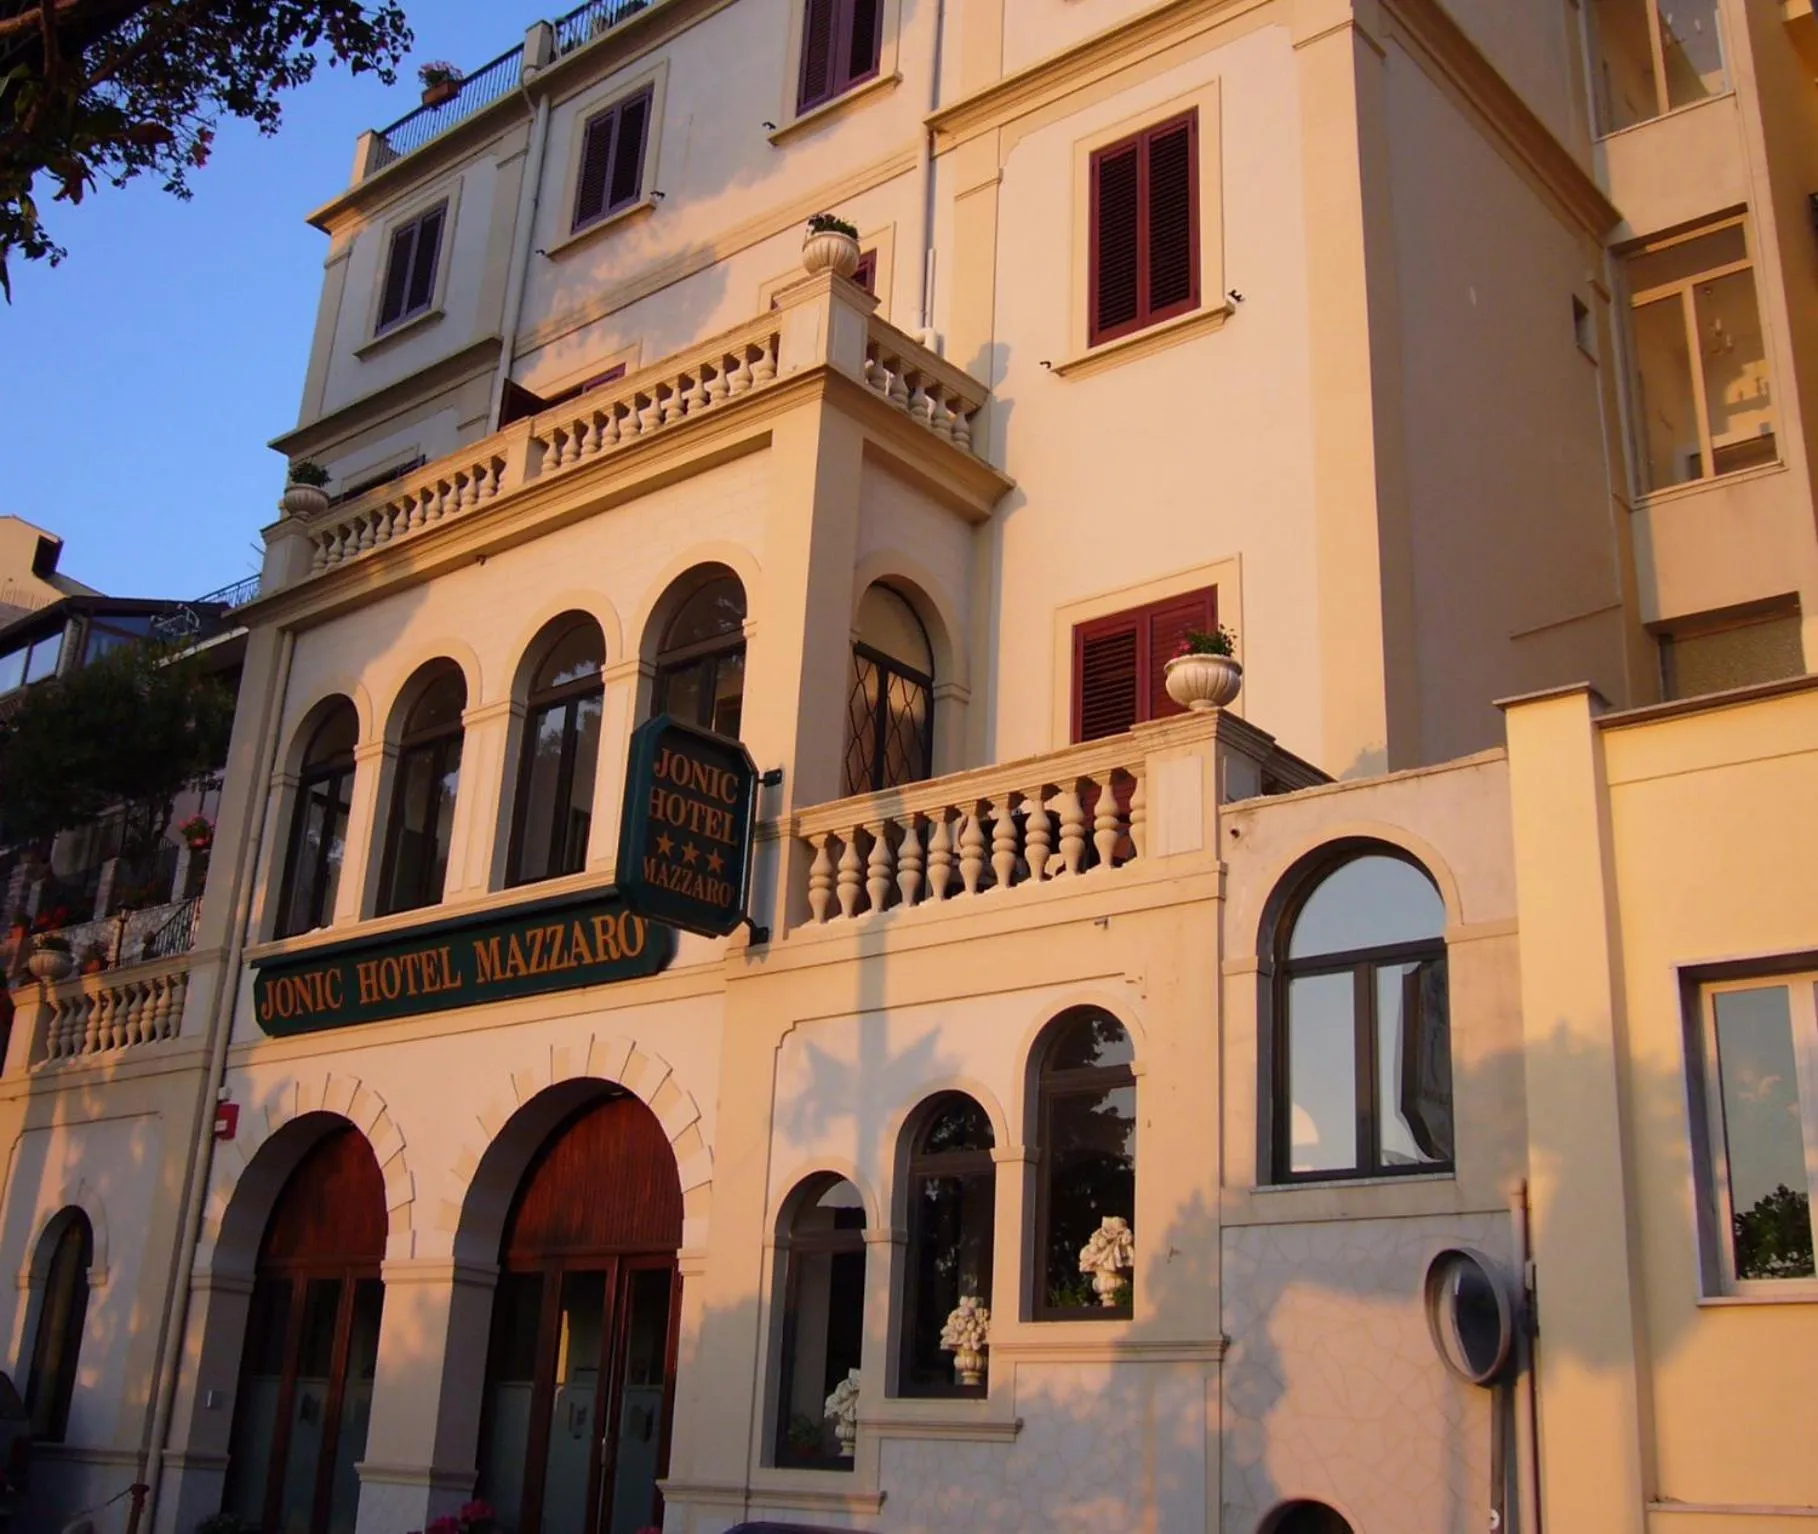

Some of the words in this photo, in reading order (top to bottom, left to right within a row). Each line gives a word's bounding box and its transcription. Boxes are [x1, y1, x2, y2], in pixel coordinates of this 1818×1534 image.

[654, 748, 739, 804] JONIC
[650, 785, 738, 847] HOTEL
[261, 967, 344, 1021] JONIC
[356, 946, 462, 1005] HOTEL
